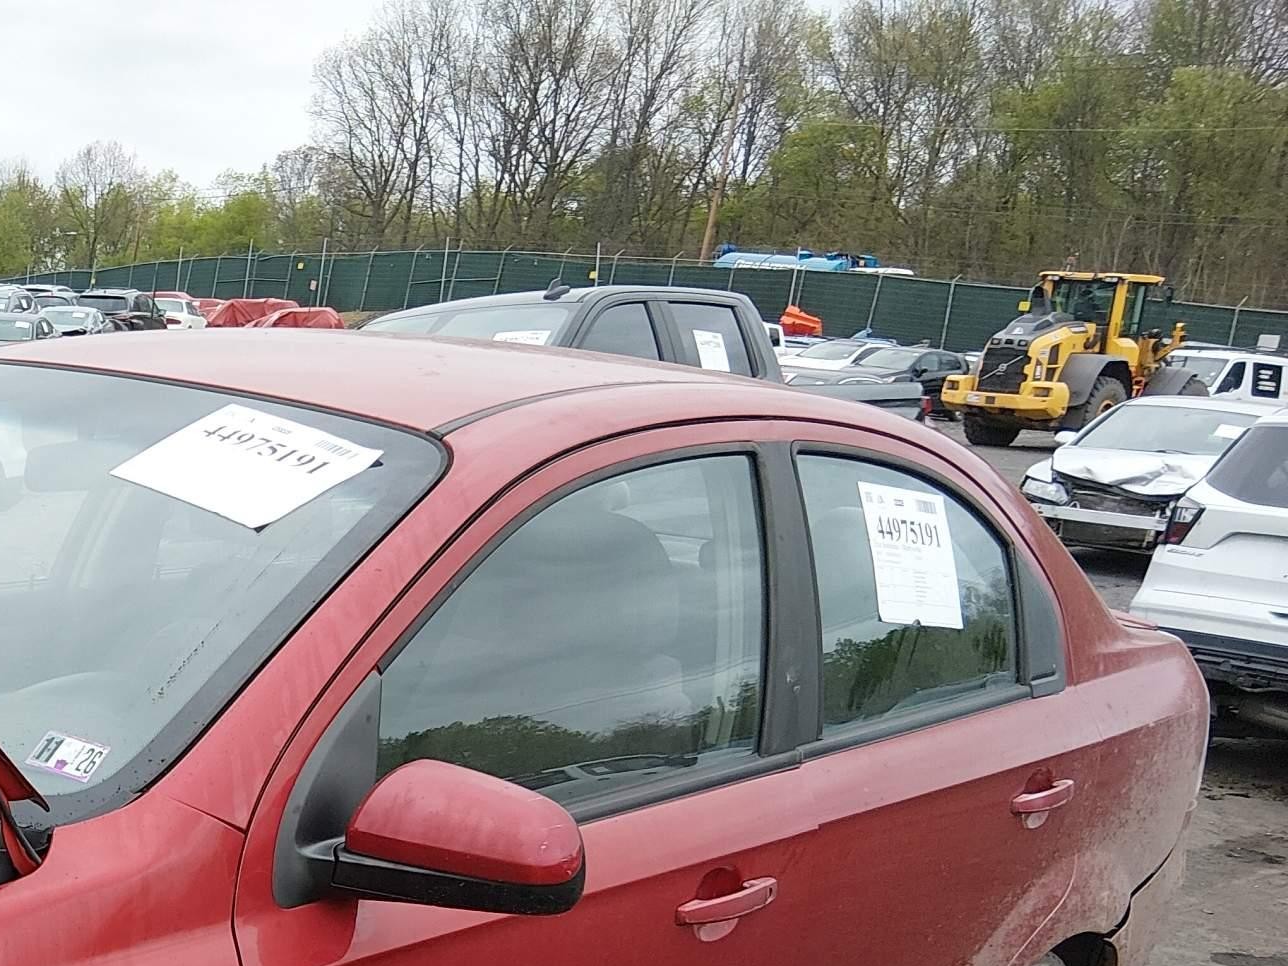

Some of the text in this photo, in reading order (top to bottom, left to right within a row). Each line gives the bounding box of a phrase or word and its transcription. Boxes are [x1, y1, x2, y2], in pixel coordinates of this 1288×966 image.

[203, 425, 331, 474] 44975191
[877, 515, 941, 548] 44975191
[35, 736, 103, 774] 11 26
